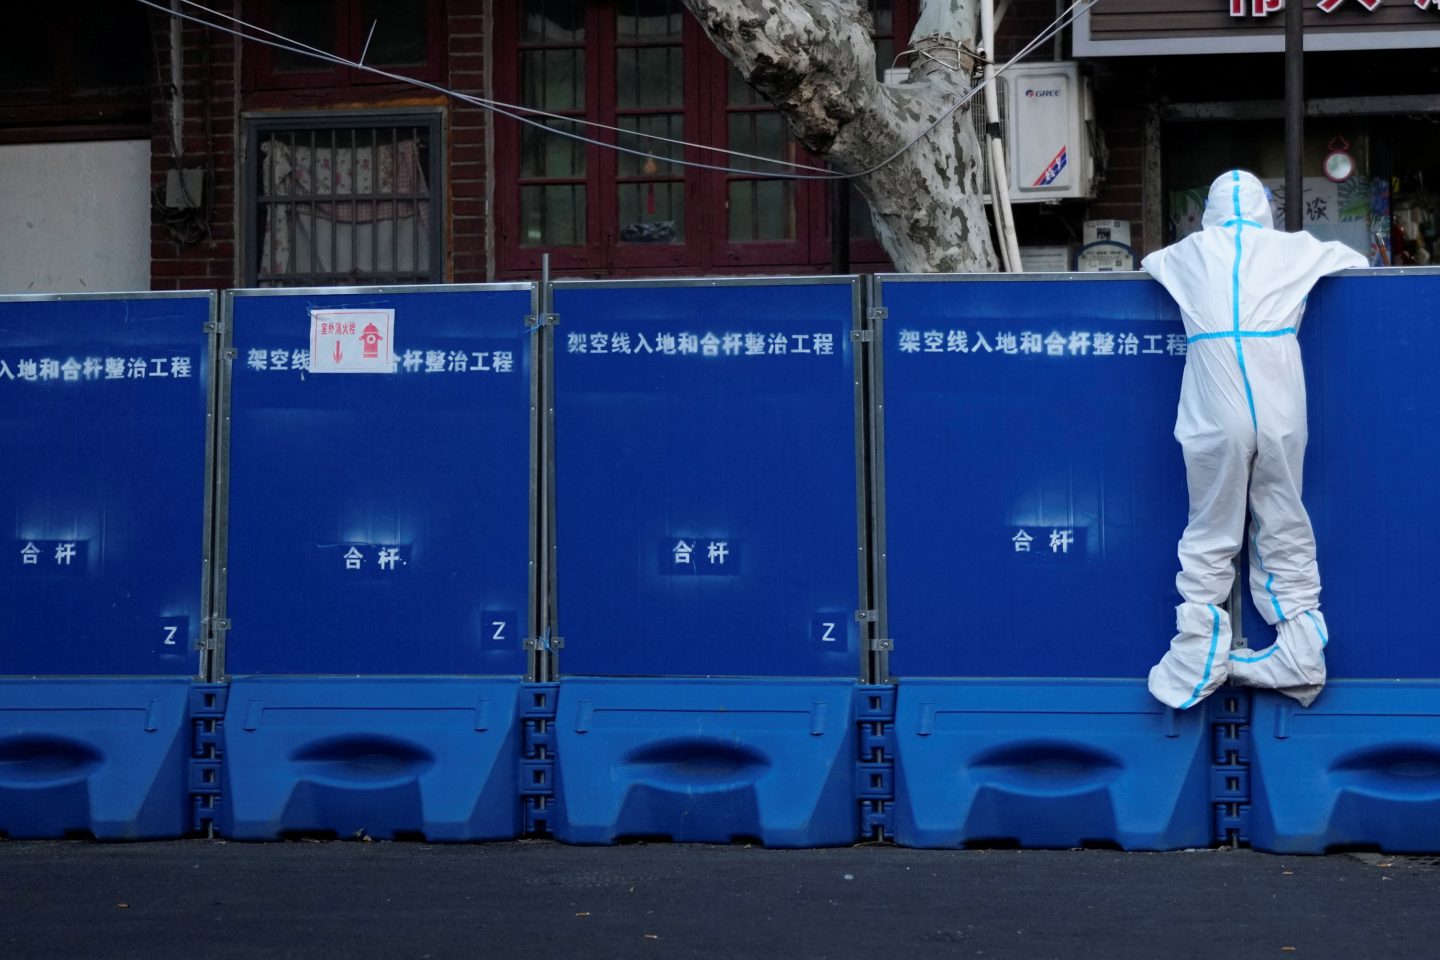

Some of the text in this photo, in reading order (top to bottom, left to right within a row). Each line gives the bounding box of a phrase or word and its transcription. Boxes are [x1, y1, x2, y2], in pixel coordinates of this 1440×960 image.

[1034, 89, 1062, 98] GREE
[321, 322, 356, 336] 室外消火栓
[567, 332, 834, 356] 架空线入地和合杆整治工程
[899, 330, 1187, 356] 架空线入地和合杆整治工程
